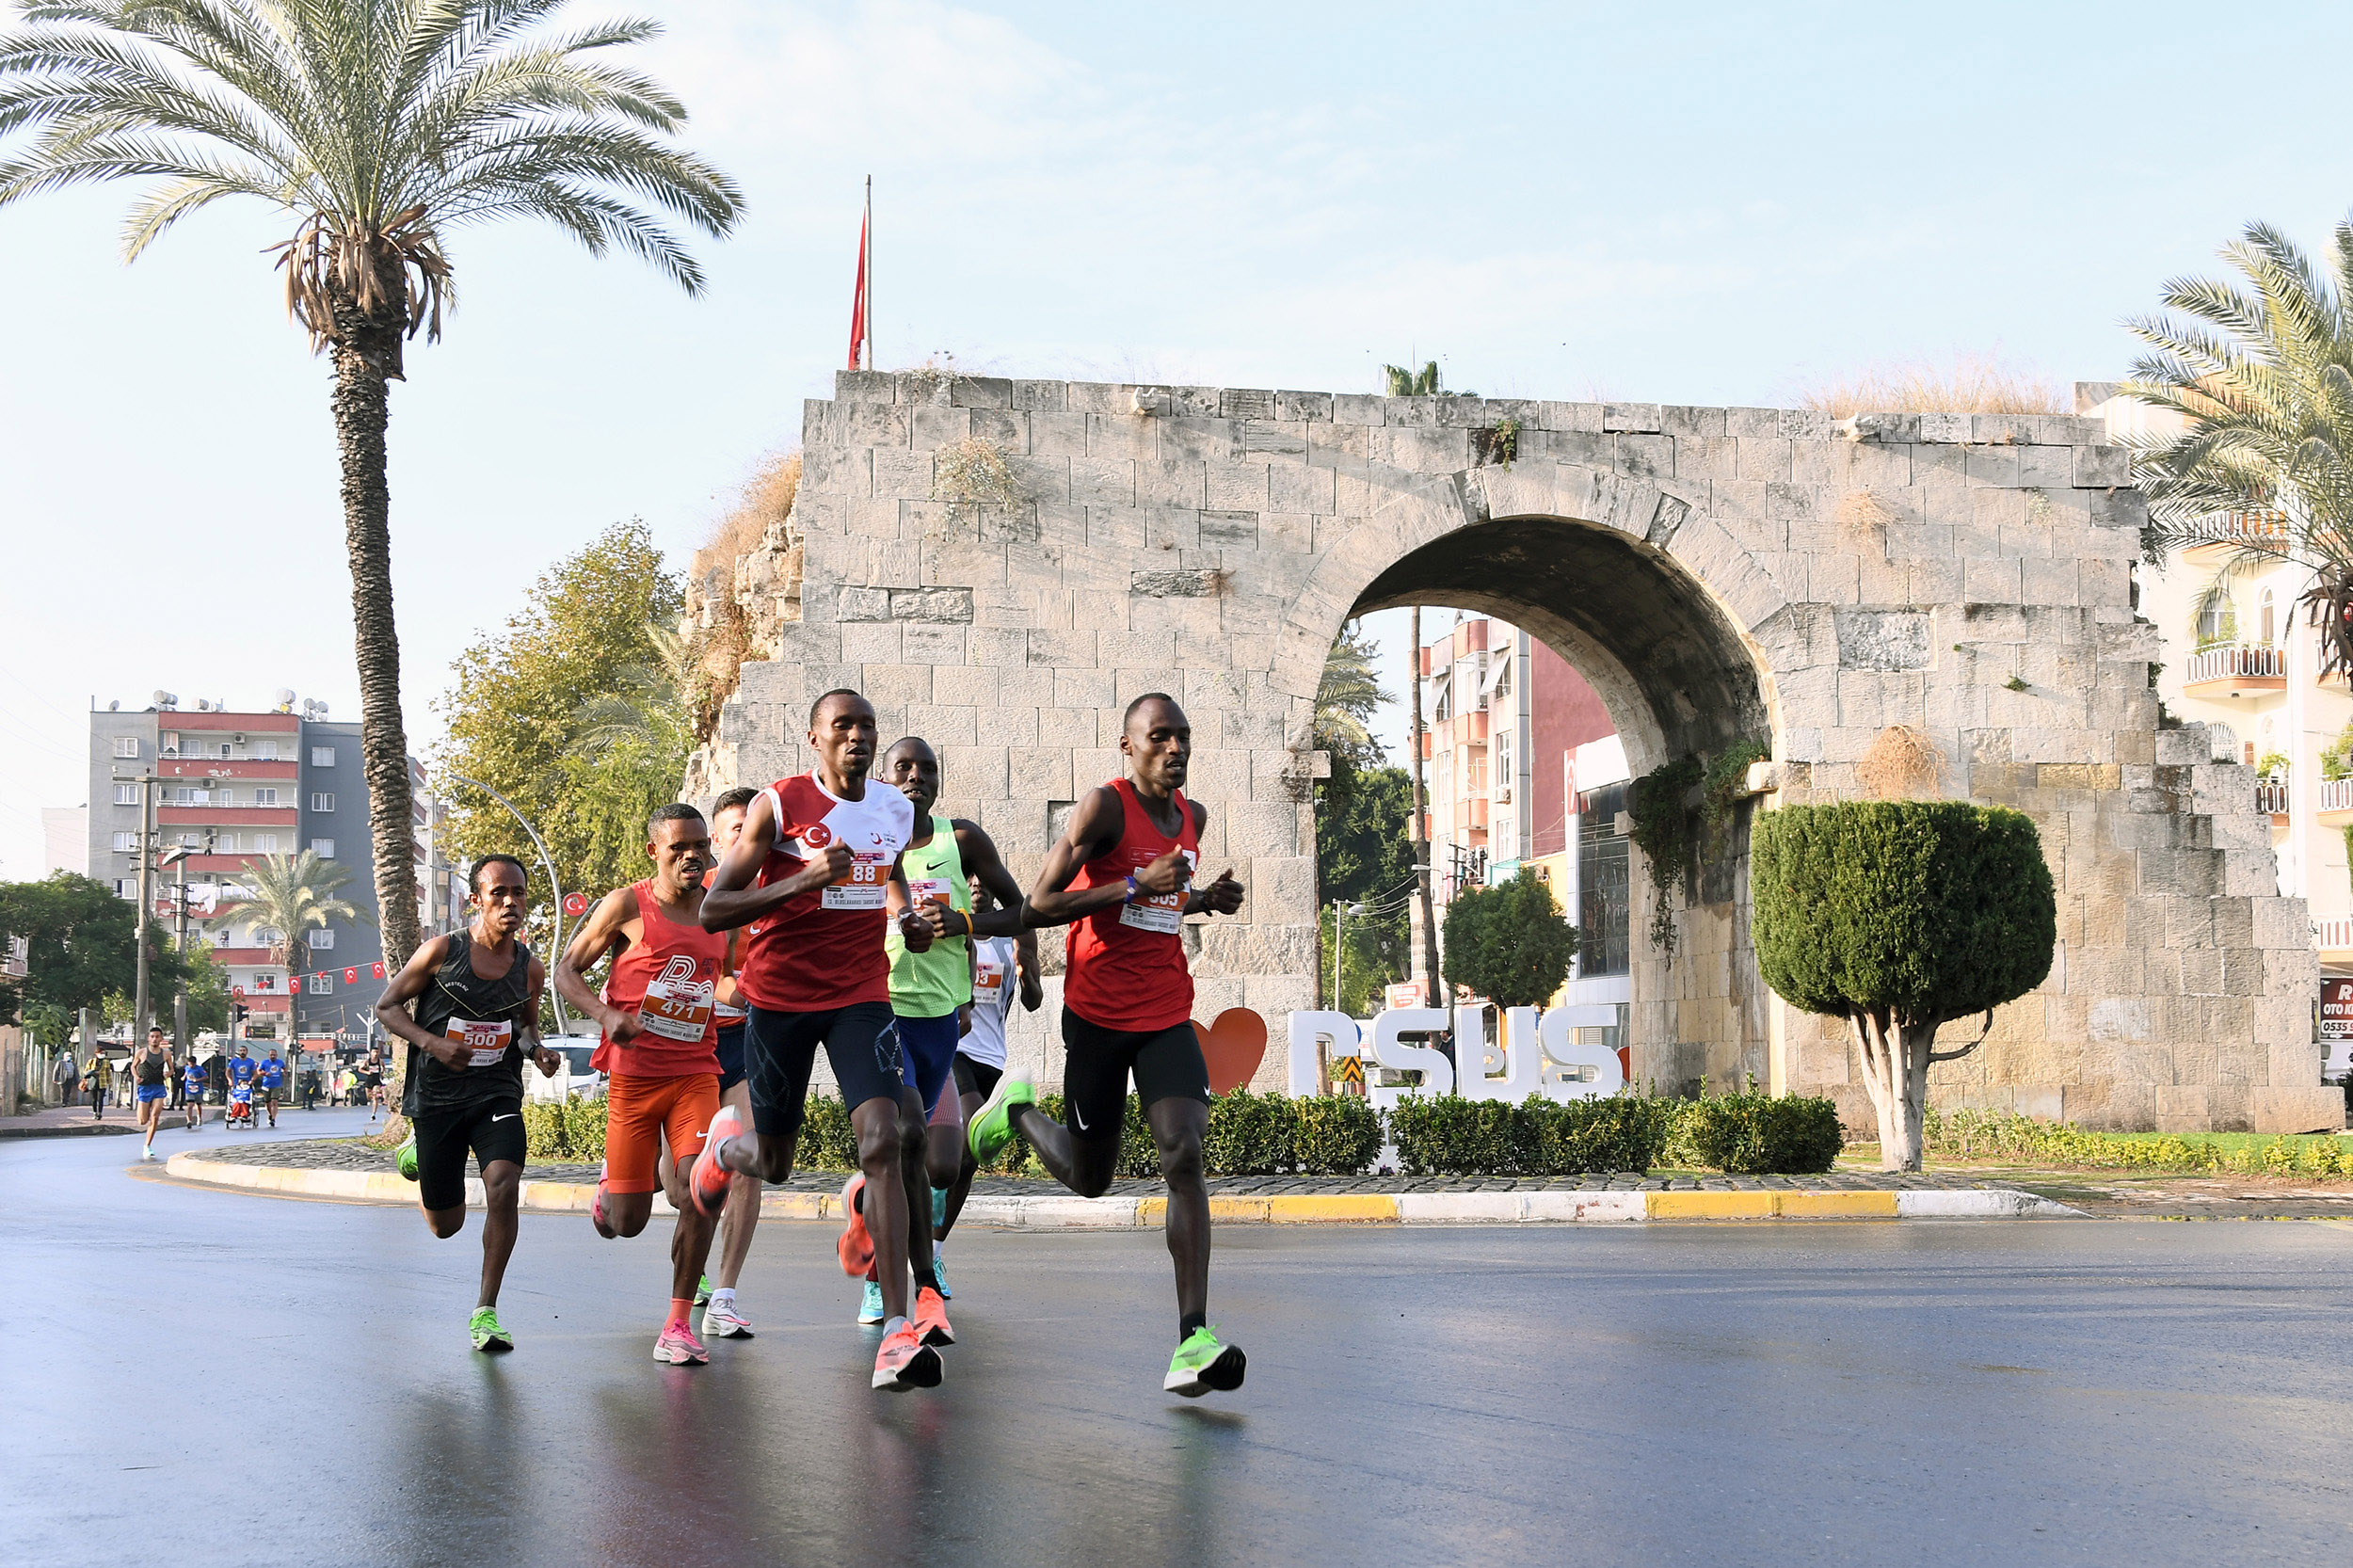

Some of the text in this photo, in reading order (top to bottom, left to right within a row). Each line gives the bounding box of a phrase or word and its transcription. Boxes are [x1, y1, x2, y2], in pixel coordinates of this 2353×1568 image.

[853, 865, 876, 883] 88
[661, 1000, 695, 1019] 471
[2323, 1003, 2344, 1016] OTO
[2323, 1022, 2348, 1032] 0535
[464, 1033, 497, 1047] 500
